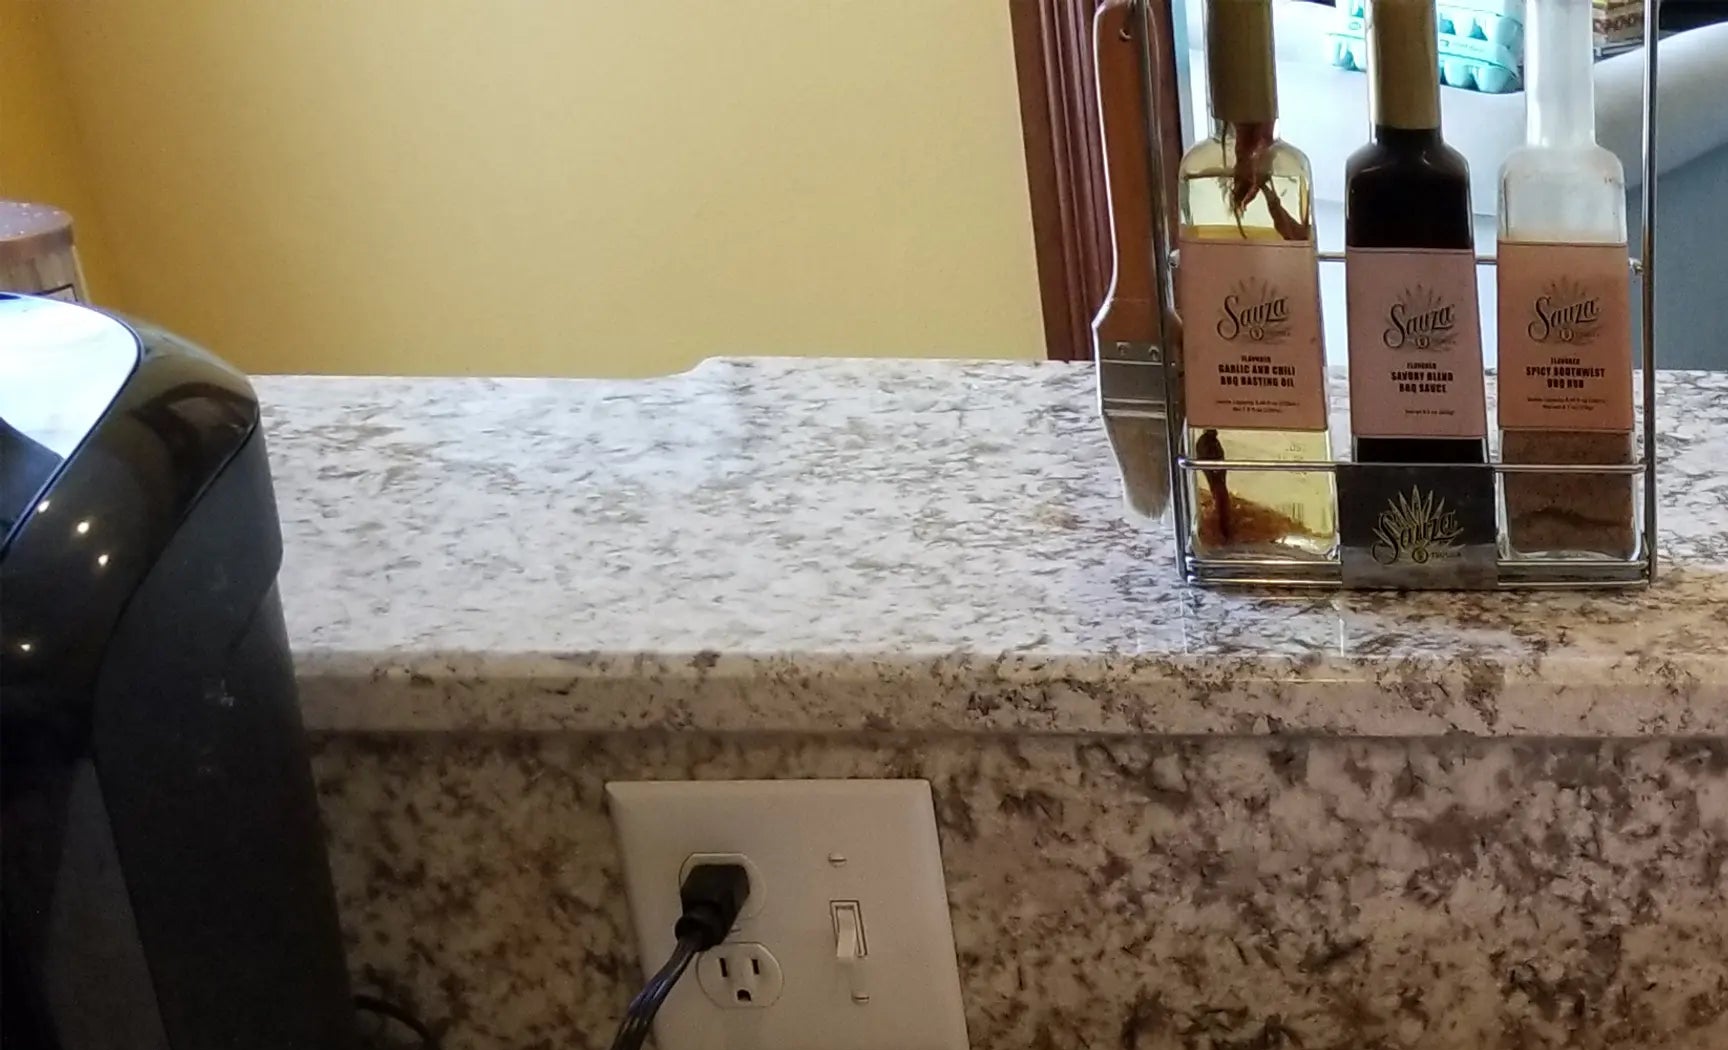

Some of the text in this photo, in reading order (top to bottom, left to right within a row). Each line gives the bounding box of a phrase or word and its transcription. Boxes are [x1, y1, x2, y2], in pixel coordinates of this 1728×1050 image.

[1217, 295, 1290, 340] Sauza
[1528, 296, 1600, 341] Sauza
[1384, 303, 1456, 348] Sauza
[1218, 364, 1295, 376] GARLIC AND CHILI
[1526, 366, 1605, 377] SPICY SOUTHWEST
[1221, 376, 1295, 387] BBQ BASTING OIL
[1391, 371, 1454, 382] SAVORY BLEND
[1399, 383, 1447, 393] BBQ SAUCE
[1371, 510, 1458, 565] Sauza
